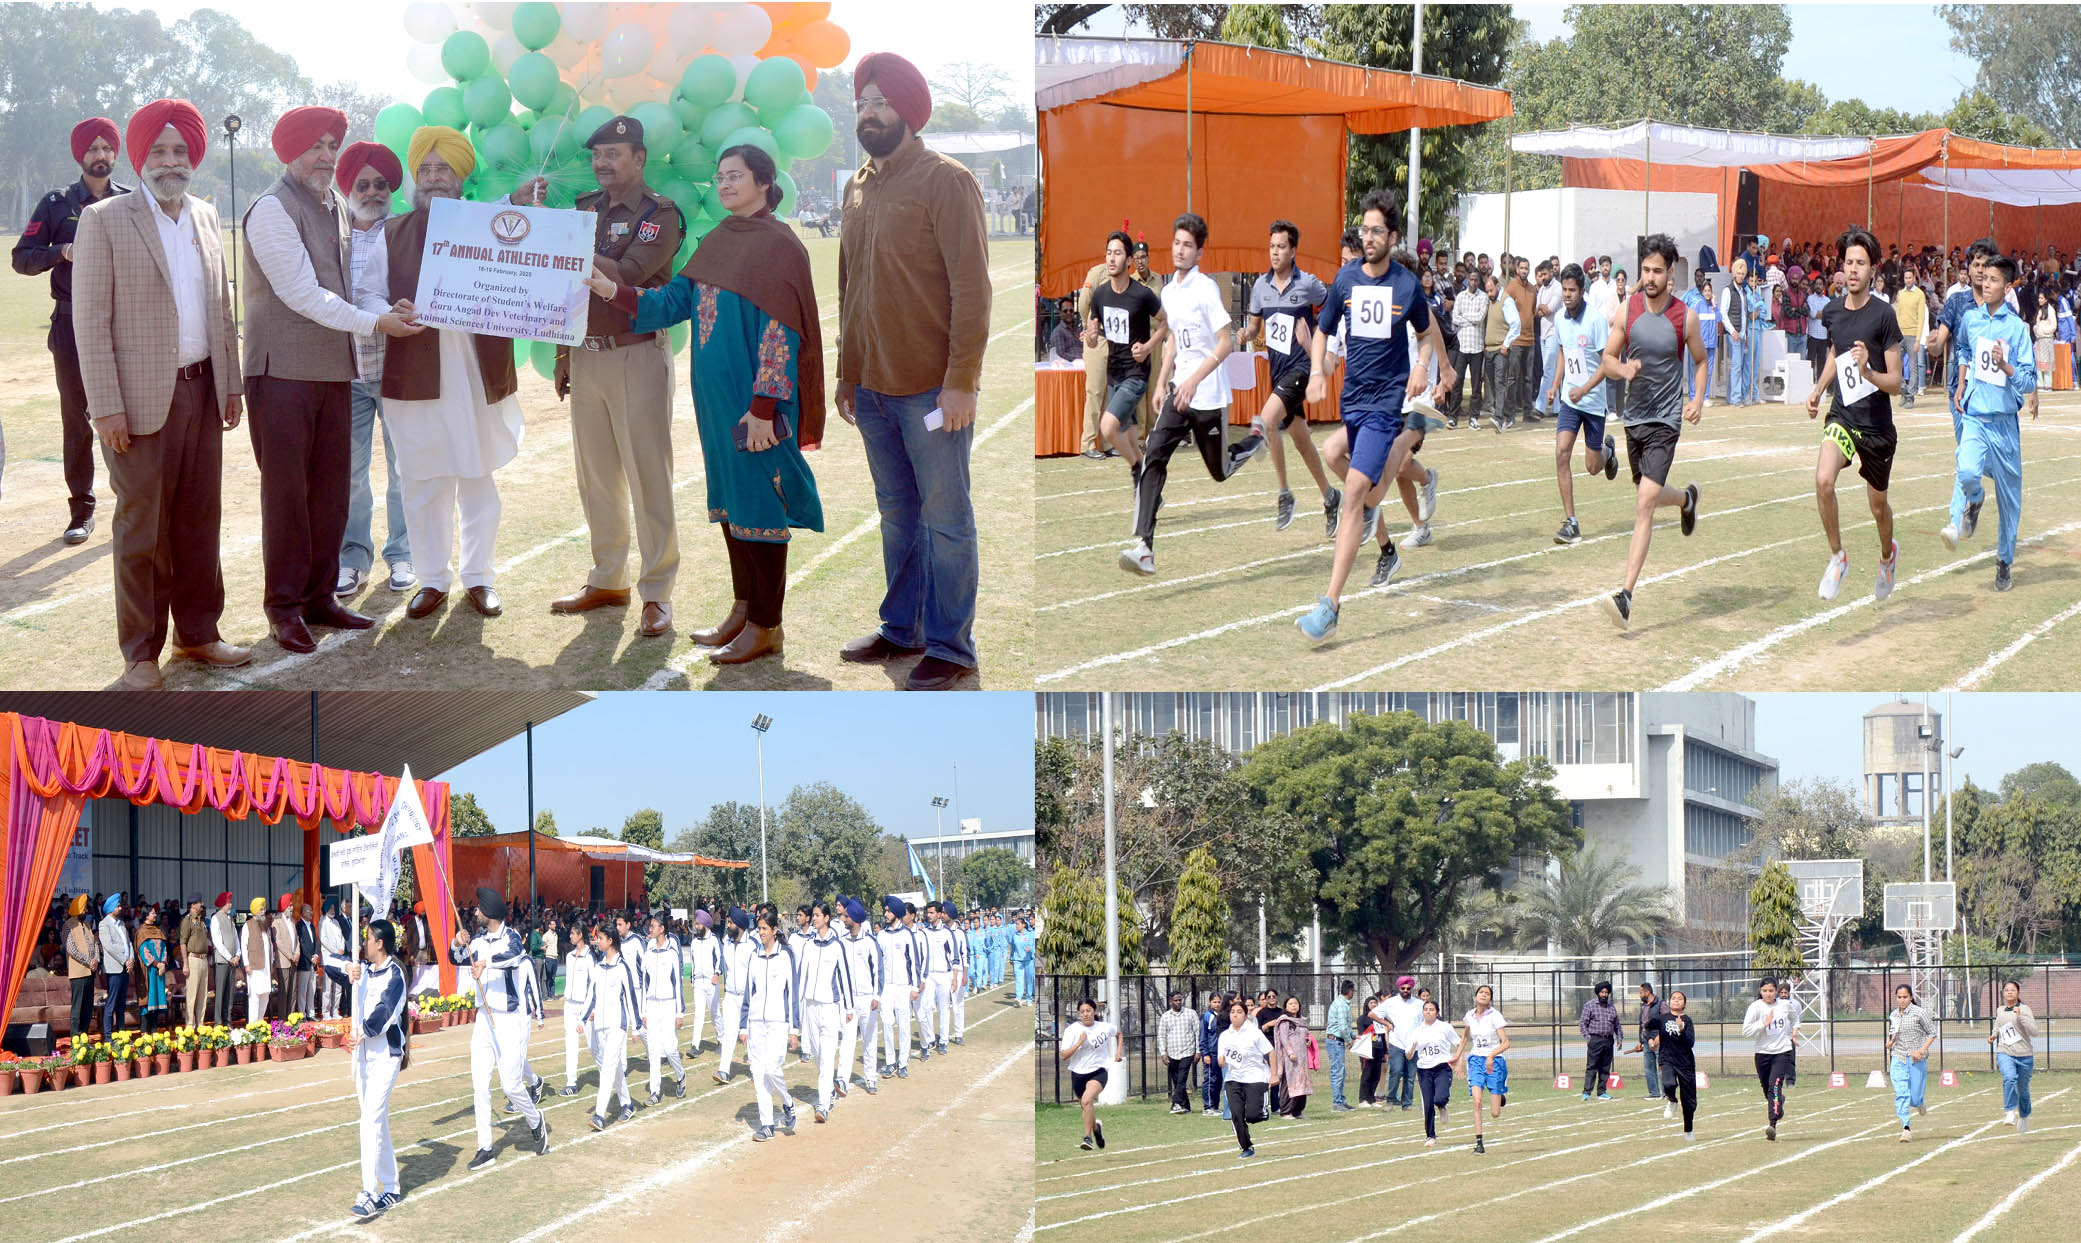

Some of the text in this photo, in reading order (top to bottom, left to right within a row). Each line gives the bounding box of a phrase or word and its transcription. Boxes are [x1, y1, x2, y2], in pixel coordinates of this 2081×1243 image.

[432, 240, 585, 272] 17th ANNUAL ATHLETIC MEET
[473, 280, 529, 296] Organized by
[433, 288, 567, 313] Directorate of Student's Welfare
[430, 300, 566, 327] Guru Angad Dev Veterinary and
[1360, 300, 1384, 324] 50
[418, 313, 575, 341] Animal Sciences University, Ludhiana
[1106, 316, 1127, 334] 191
[1271, 322, 1287, 342] 28
[1225, 1048, 1243, 1063] 189
[1422, 1045, 1440, 1056] 185
[1557, 1075, 1569, 1088] 8
[1608, 1074, 1620, 1088] 7
[1831, 1073, 1844, 1087] 5
